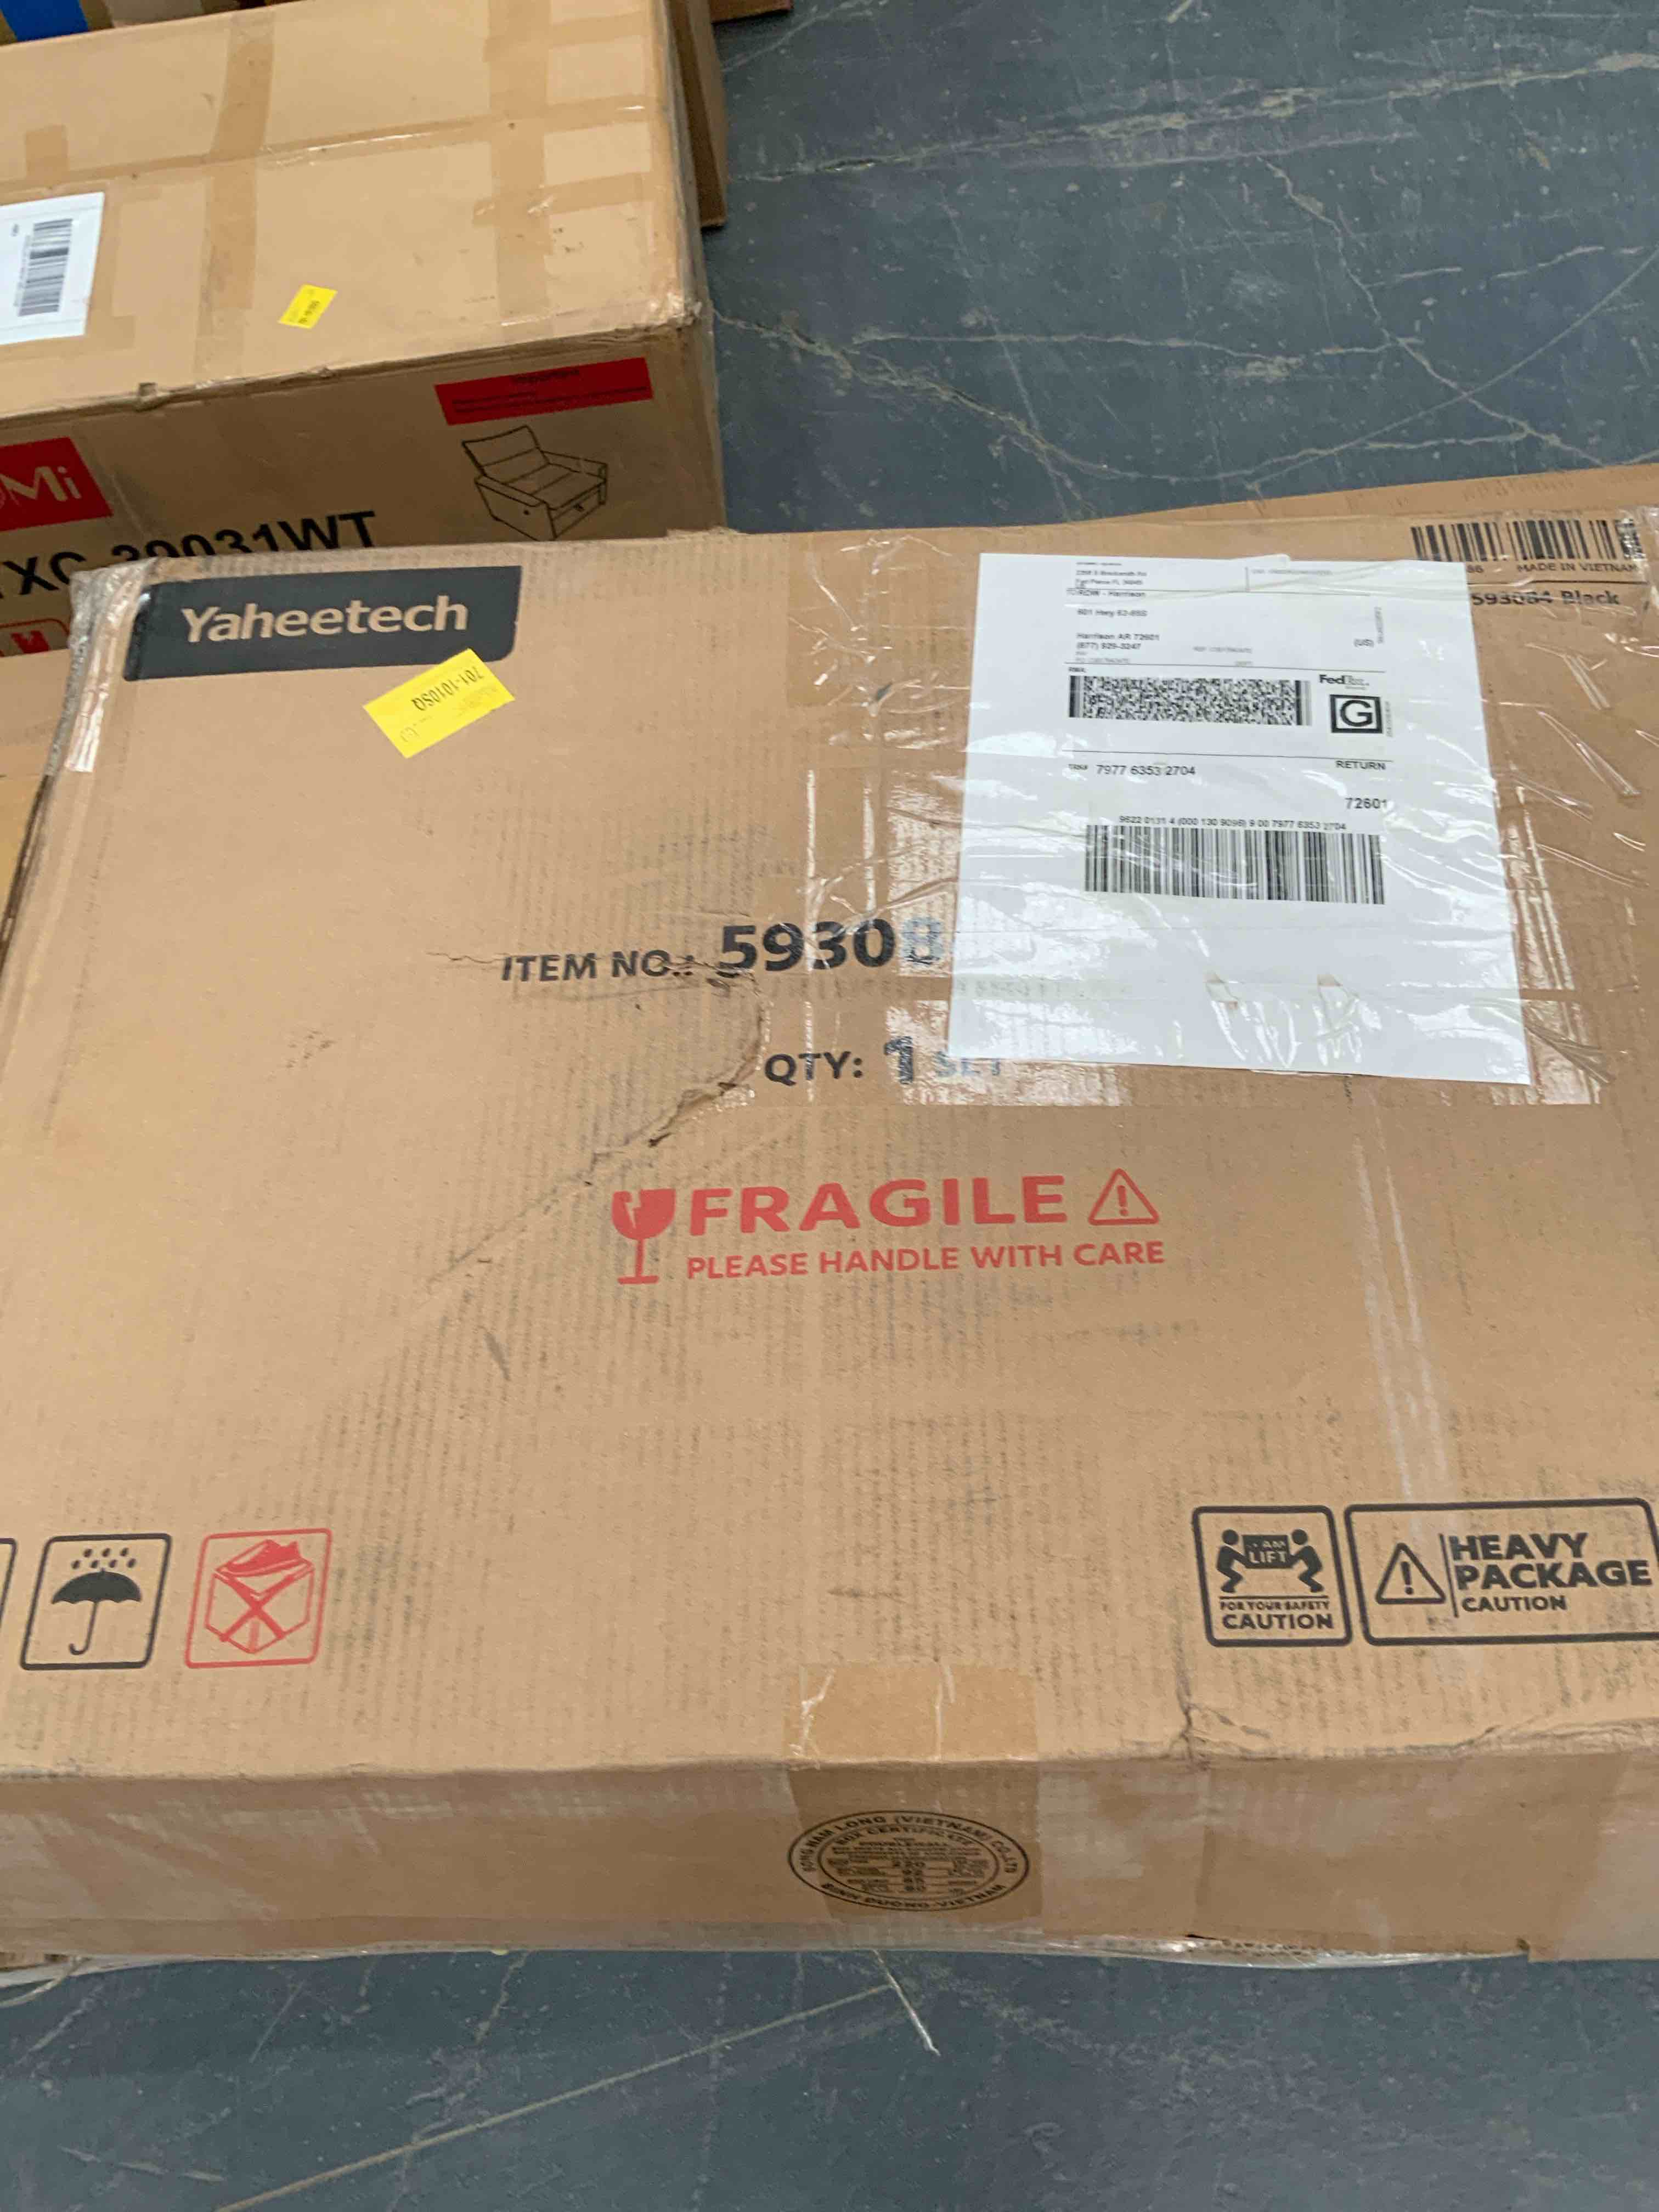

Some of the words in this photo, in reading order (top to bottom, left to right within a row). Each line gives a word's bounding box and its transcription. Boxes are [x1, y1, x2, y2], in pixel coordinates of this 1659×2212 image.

[0, 466, 82, 508] Mi
[1518, 563, 1556, 572] MADE
[1561, 562, 1576, 572] IN
[1560, 589, 1620, 605] Black
[182, 595, 468, 643] Yaheetech
[1340, 699, 1373, 727] G
[1096, 764, 1126, 775] 7977
[1130, 765, 1161, 776] 6353
[1166, 765, 1196, 775] 2704
[1335, 760, 1387, 770] RETURN
[1345, 797, 1387, 810] 72601
[501, 952, 597, 982] ITEM
[768, 1049, 864, 1086] QTY:
[884, 1035, 913, 1085] 1
[689, 1175, 1068, 1237] FRAGILE
[687, 1252, 808, 1279] PLEASE
[819, 1246, 959, 1273] HANDLE
[970, 1244, 1063, 1268] WITH
[1073, 1240, 1165, 1266] CARE
[1248, 1550, 1287, 1564] LIFT
[1448, 1532, 1588, 1561] HEAVY
[1454, 1560, 1653, 1590] PACKAGE
[1220, 1601, 1245, 1611] FOR
[1246, 1600, 1282, 1610] YOUR
[1284, 1600, 1330, 1610] SAFETY
[1462, 1595, 1568, 1612] CAUTION
[1222, 1613, 1334, 1629] CAUTION
